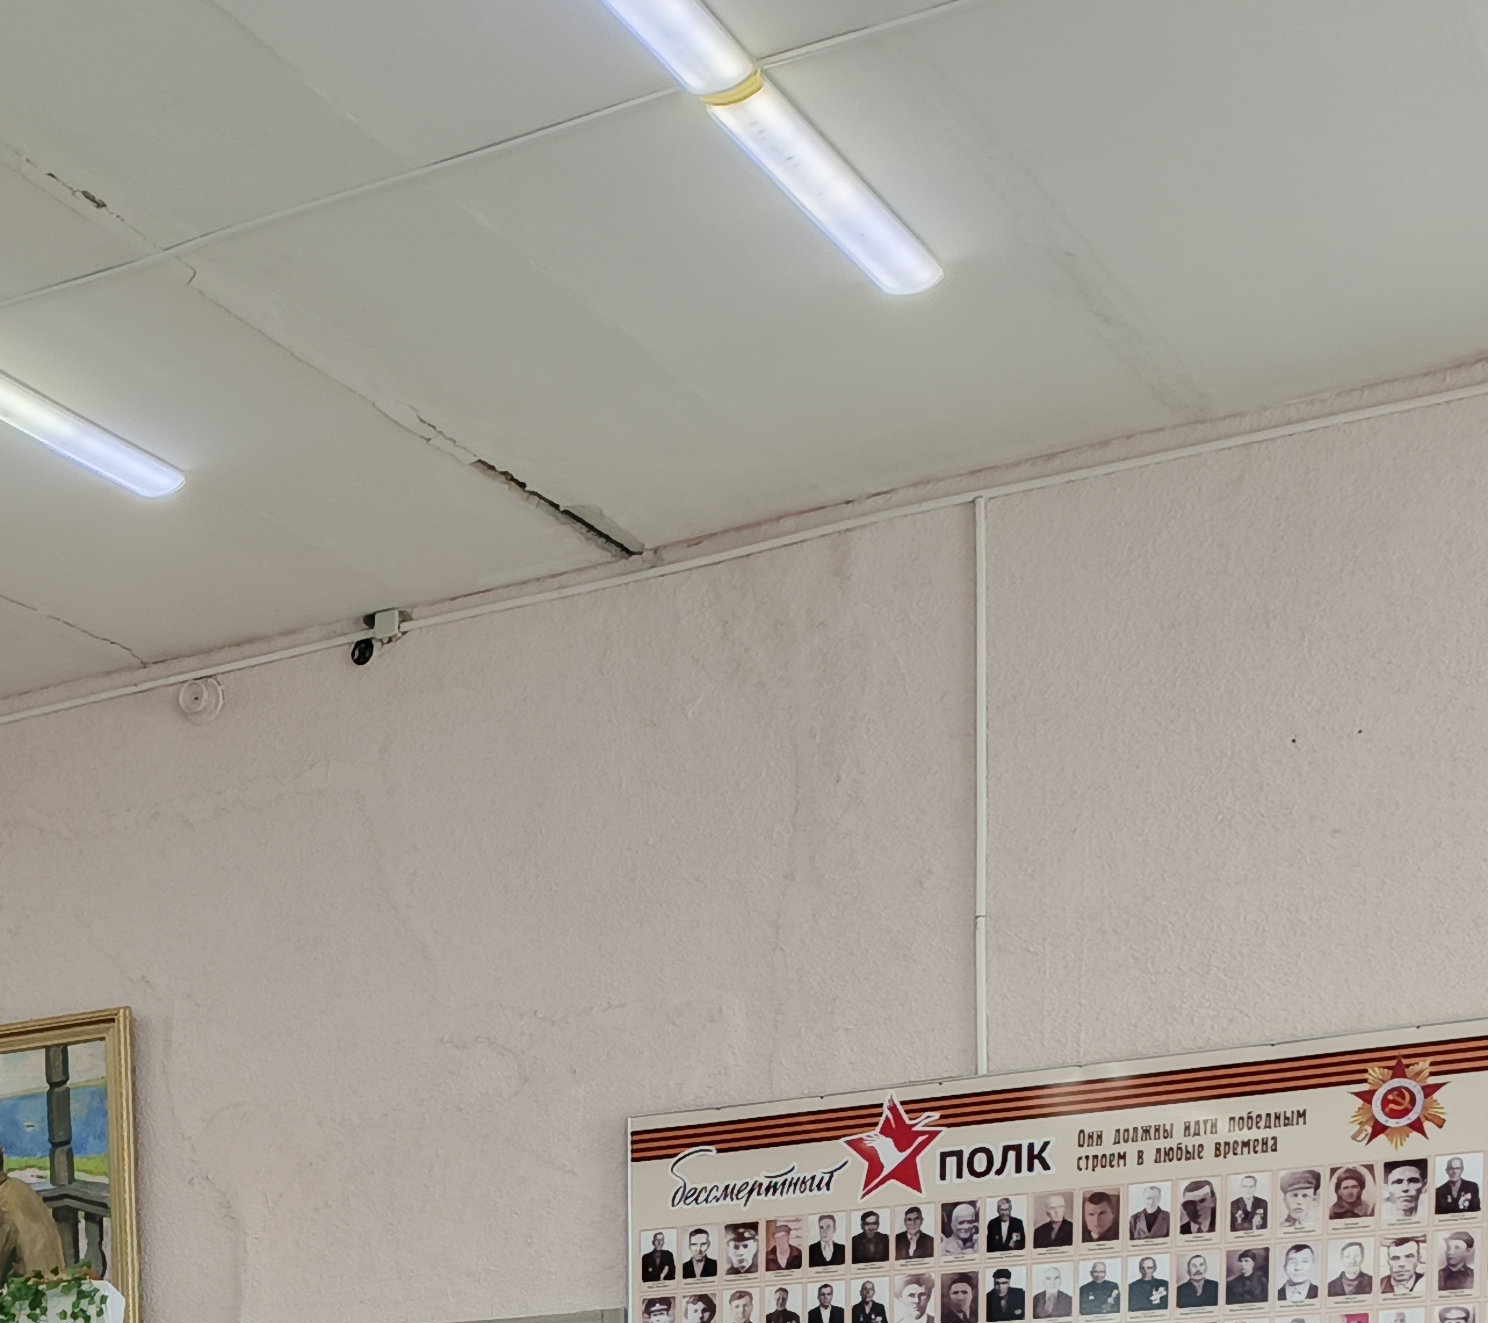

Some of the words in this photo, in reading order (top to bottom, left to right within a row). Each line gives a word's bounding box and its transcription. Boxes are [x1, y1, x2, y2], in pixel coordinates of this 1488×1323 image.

[1077, 1129, 1104, 1148] Они
[1113, 1123, 1174, 1146] должны
[1183, 1117, 1219, 1138] идти
[1227, 1108, 1308, 1133] победным
[939, 1139, 1052, 1182] ПОЛК
[1076, 1150, 1128, 1172] строем
[1136, 1150, 1144, 1166] в
[1154, 1142, 1205, 1164] любые
[1214, 1135, 1278, 1159] времена
